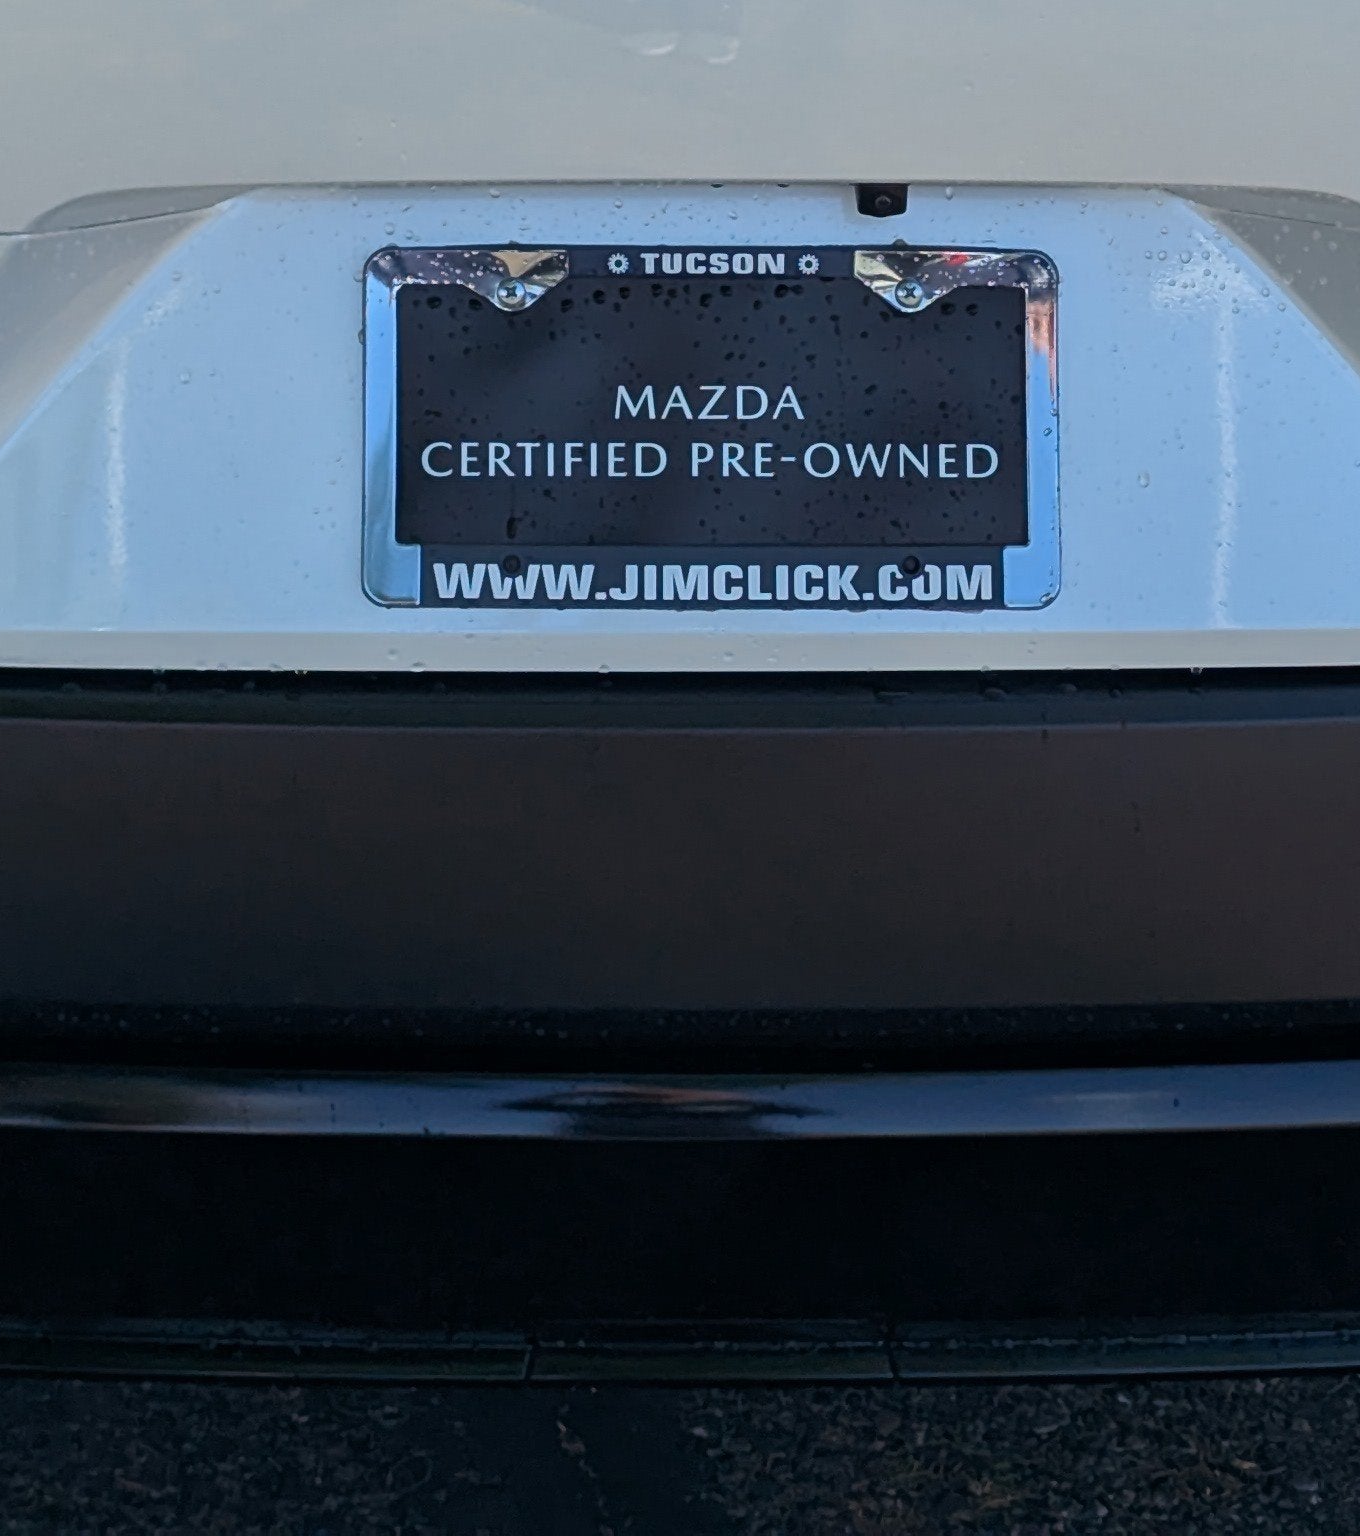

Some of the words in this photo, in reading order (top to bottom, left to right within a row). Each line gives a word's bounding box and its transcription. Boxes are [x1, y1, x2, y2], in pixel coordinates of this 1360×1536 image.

[640, 252, 785, 275] TUCSON
[614, 385, 805, 420] MAZDA
[421, 441, 667, 478] CERTIFIED
[691, 442, 999, 479] PRE-OWNED
[432, 562, 993, 602] WWW.JIMCLICK.COM
